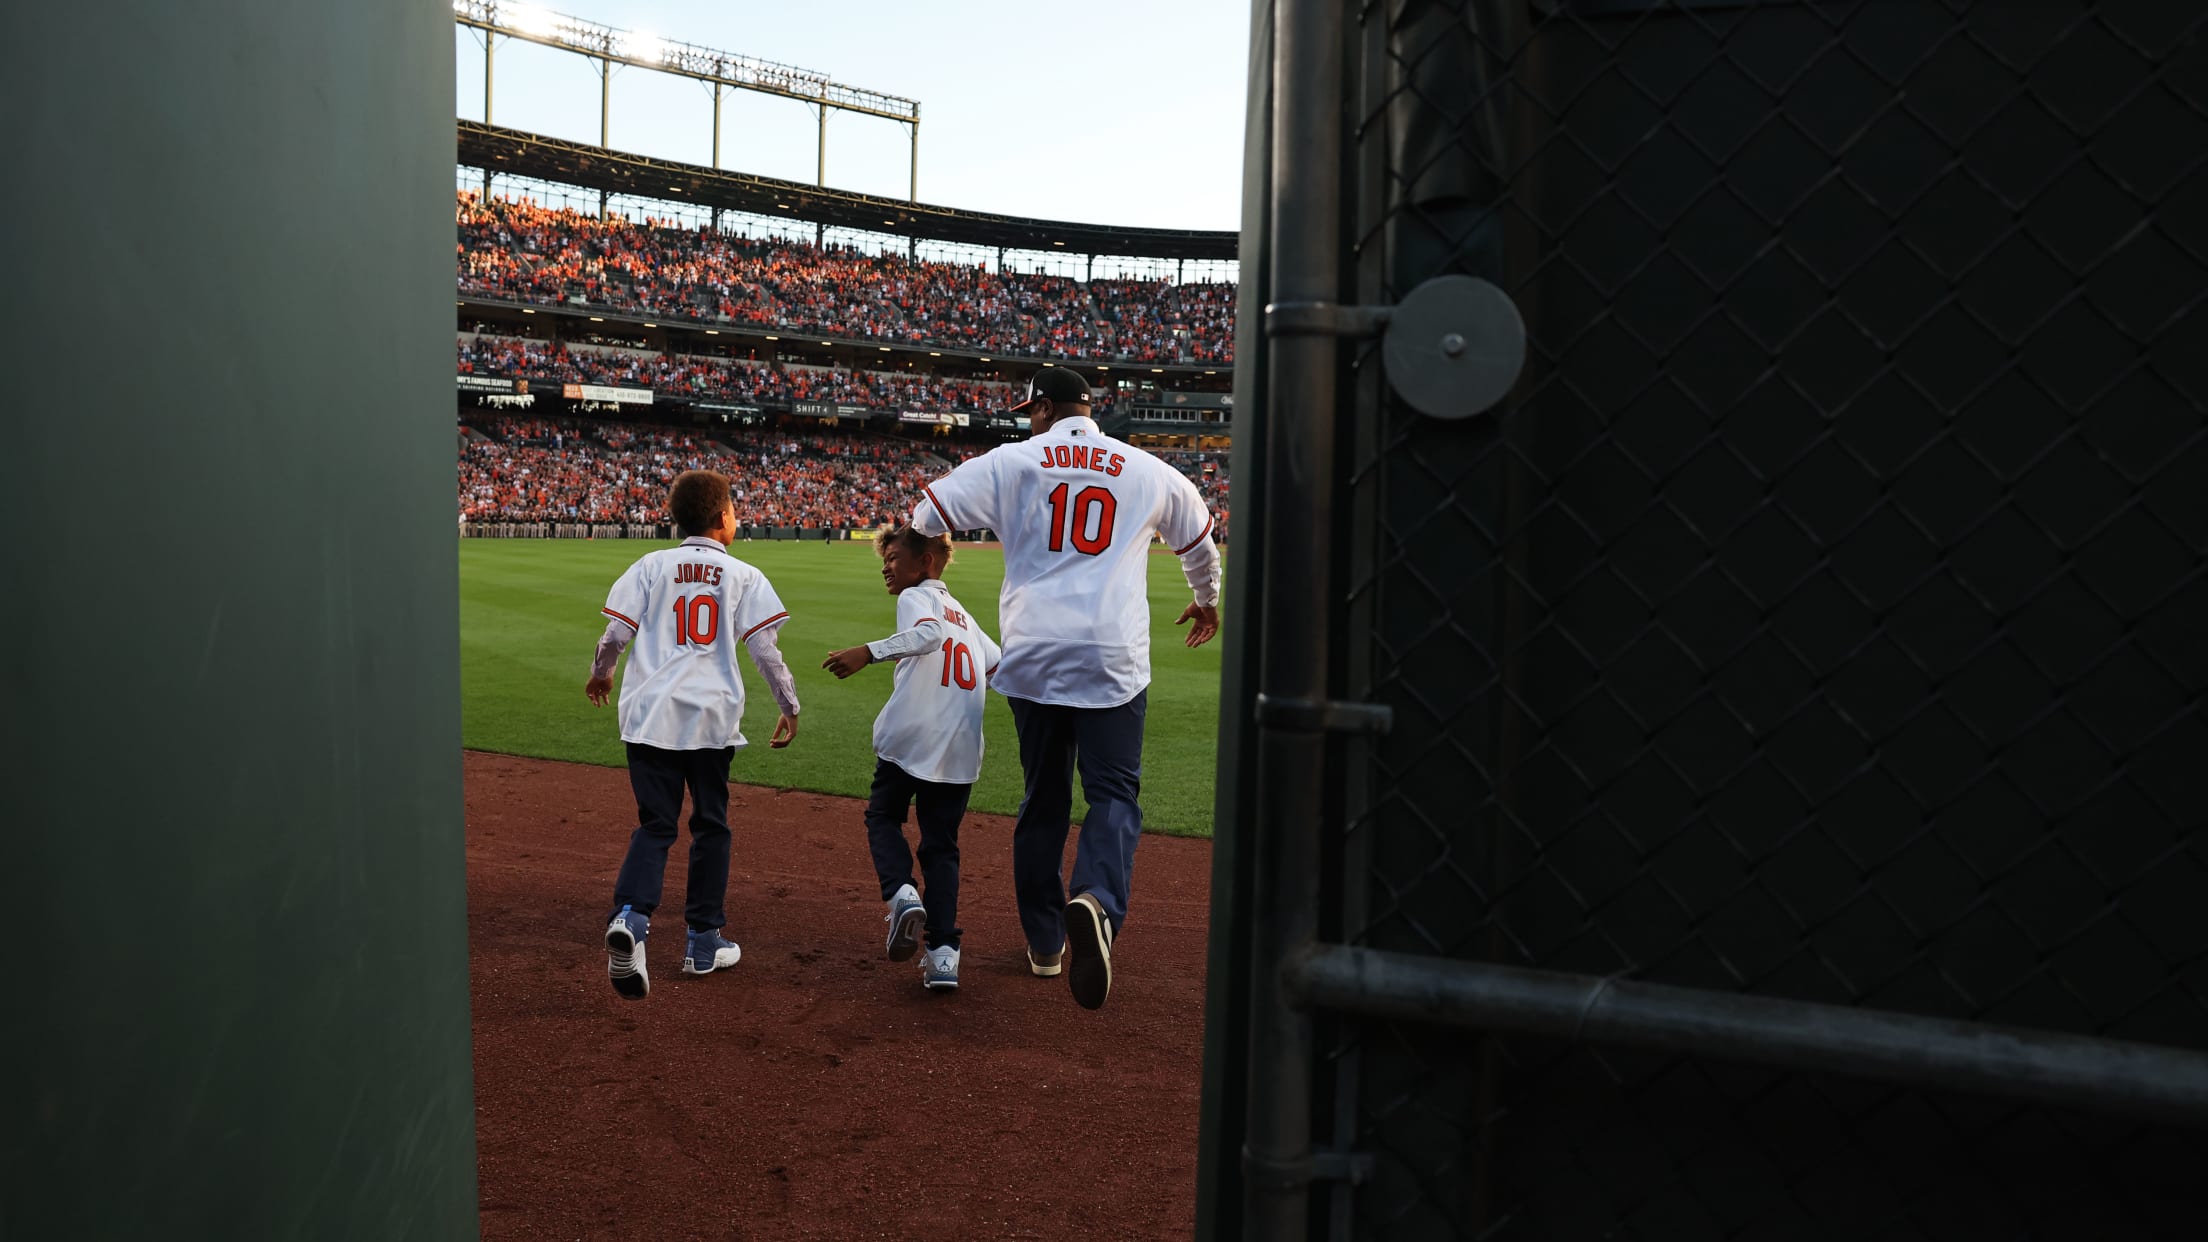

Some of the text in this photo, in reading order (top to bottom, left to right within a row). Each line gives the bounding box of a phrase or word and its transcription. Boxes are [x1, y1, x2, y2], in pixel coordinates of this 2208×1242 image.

[796, 404, 821, 414] SHIFT
[1040, 445, 1126, 477] JONES
[1048, 482, 1117, 556] 10
[674, 563, 723, 586] JONES
[673, 594, 719, 645] 10
[941, 637, 976, 691] 10
